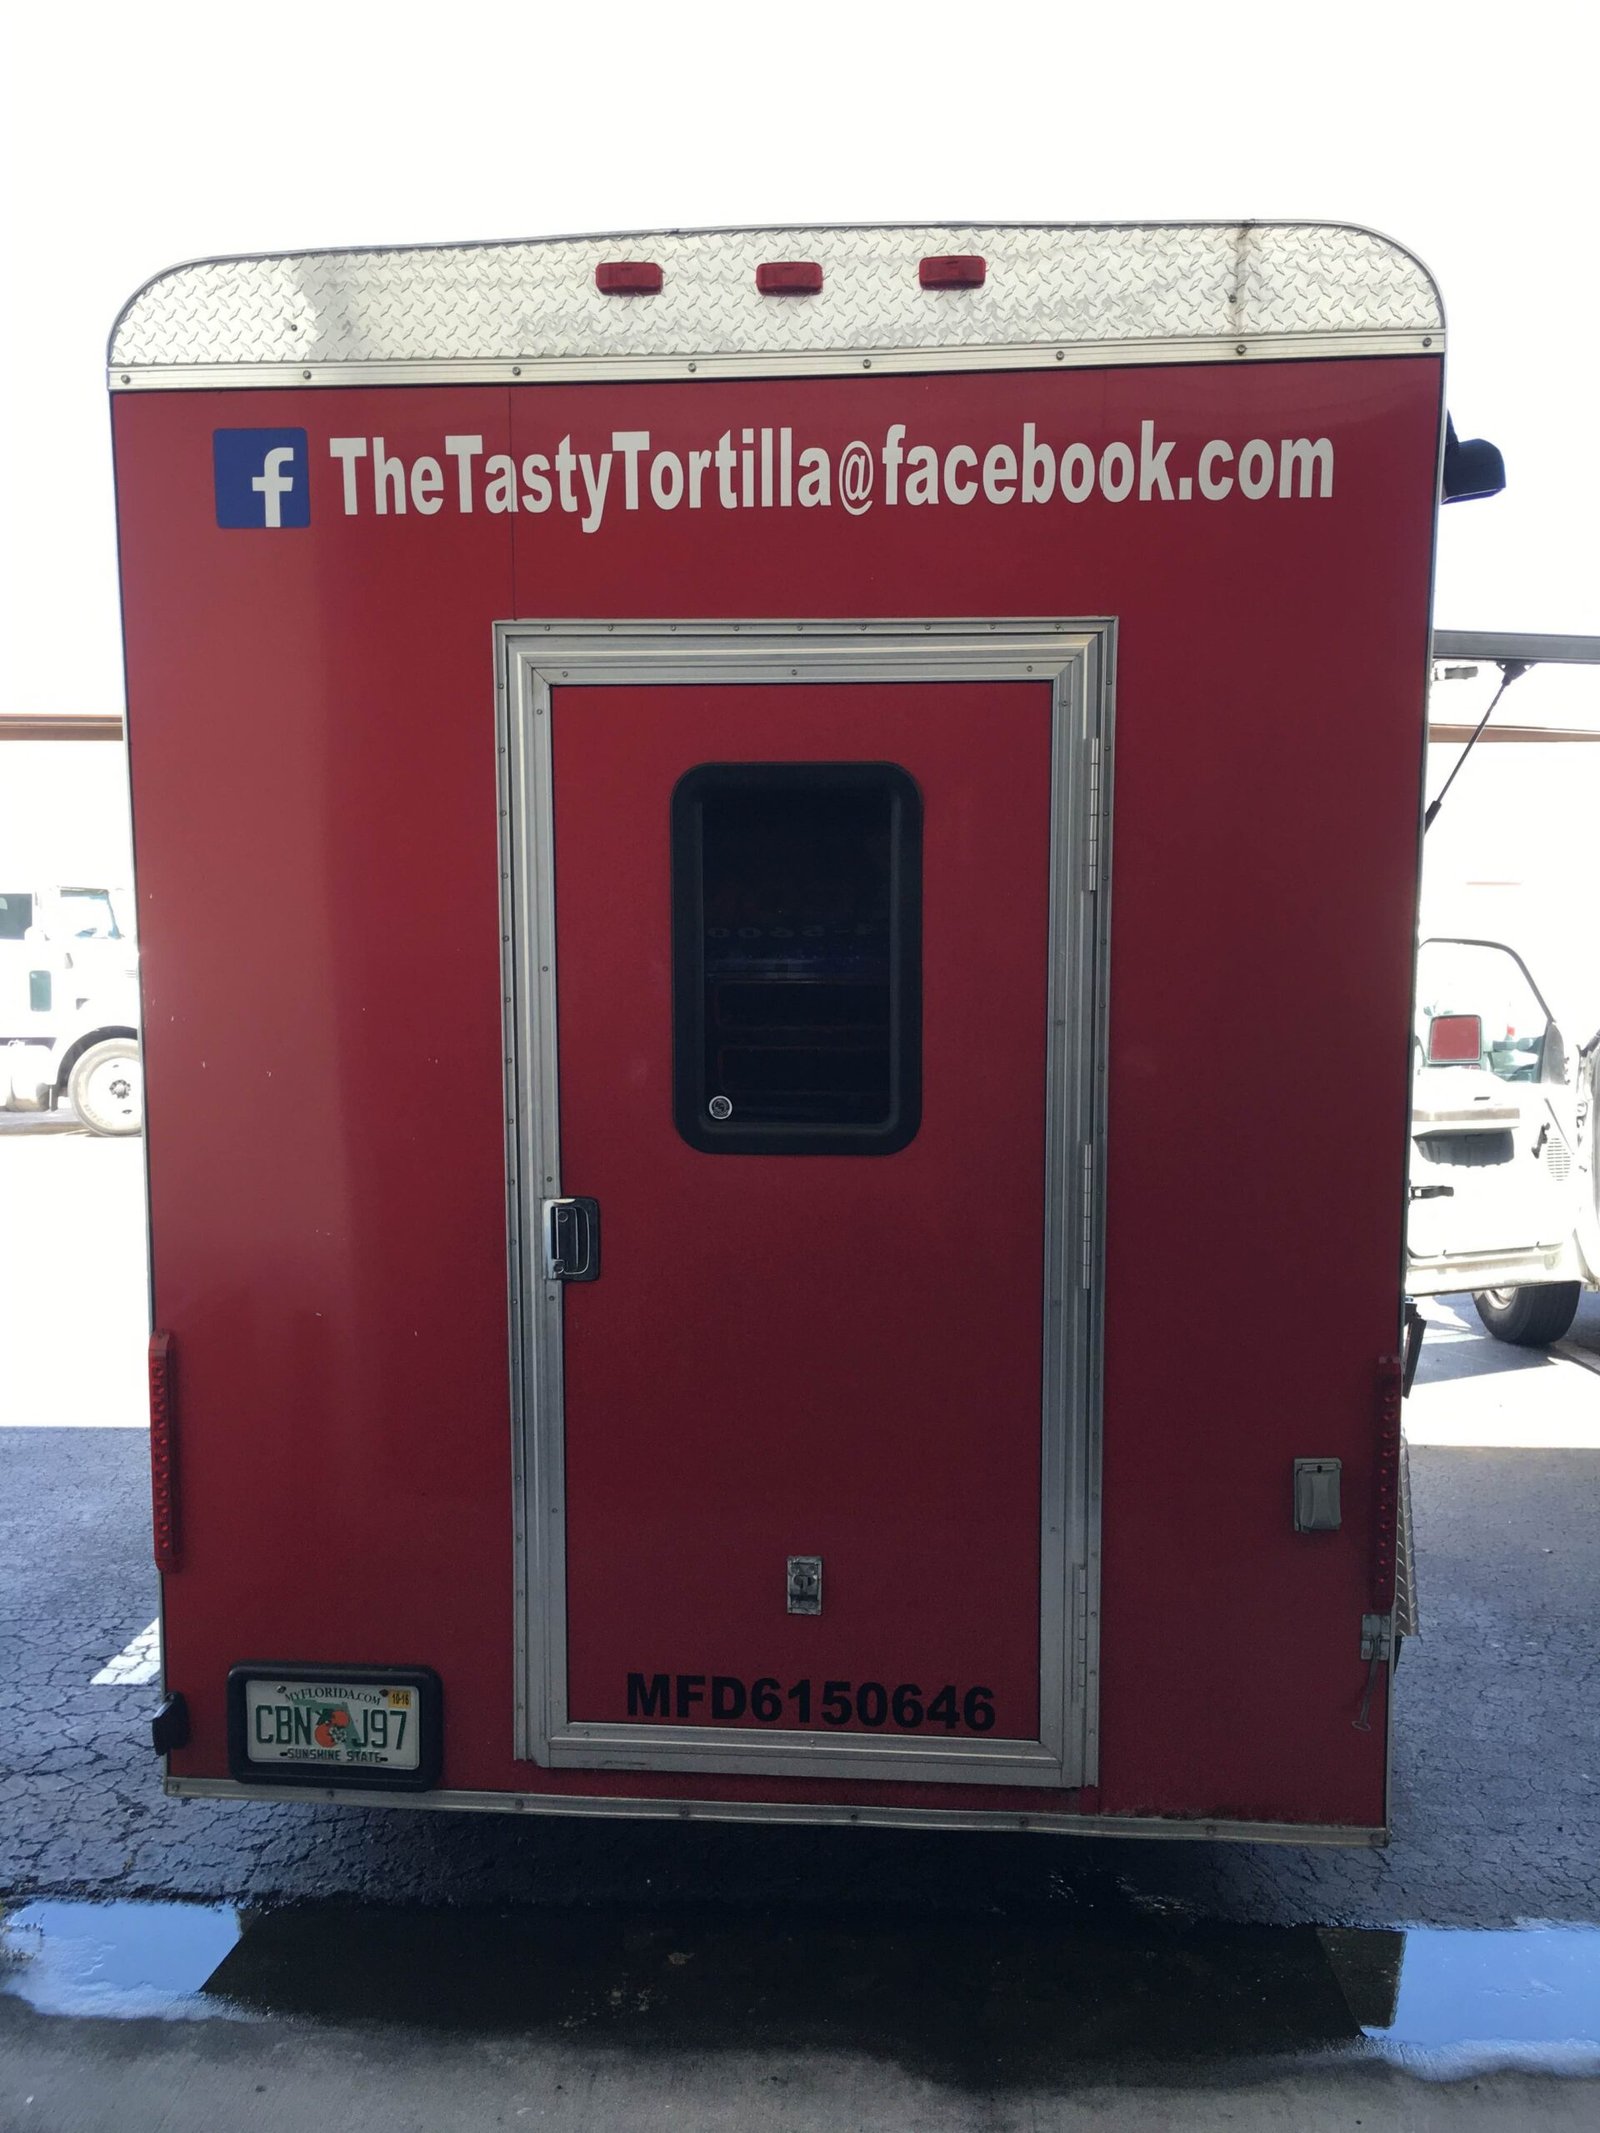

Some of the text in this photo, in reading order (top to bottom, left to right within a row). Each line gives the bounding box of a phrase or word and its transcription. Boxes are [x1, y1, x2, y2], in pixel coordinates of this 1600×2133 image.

[251, 420, 1334, 534] f TheTastyTortilla@facebook.com
[285, 1687, 381, 1706] MYFLORIDA.COM
[627, 1672, 995, 1730] MFD6150646
[256, 1705, 407, 1750] CBN J97
[287, 1748, 381, 1764] SUNSHINE STATE
